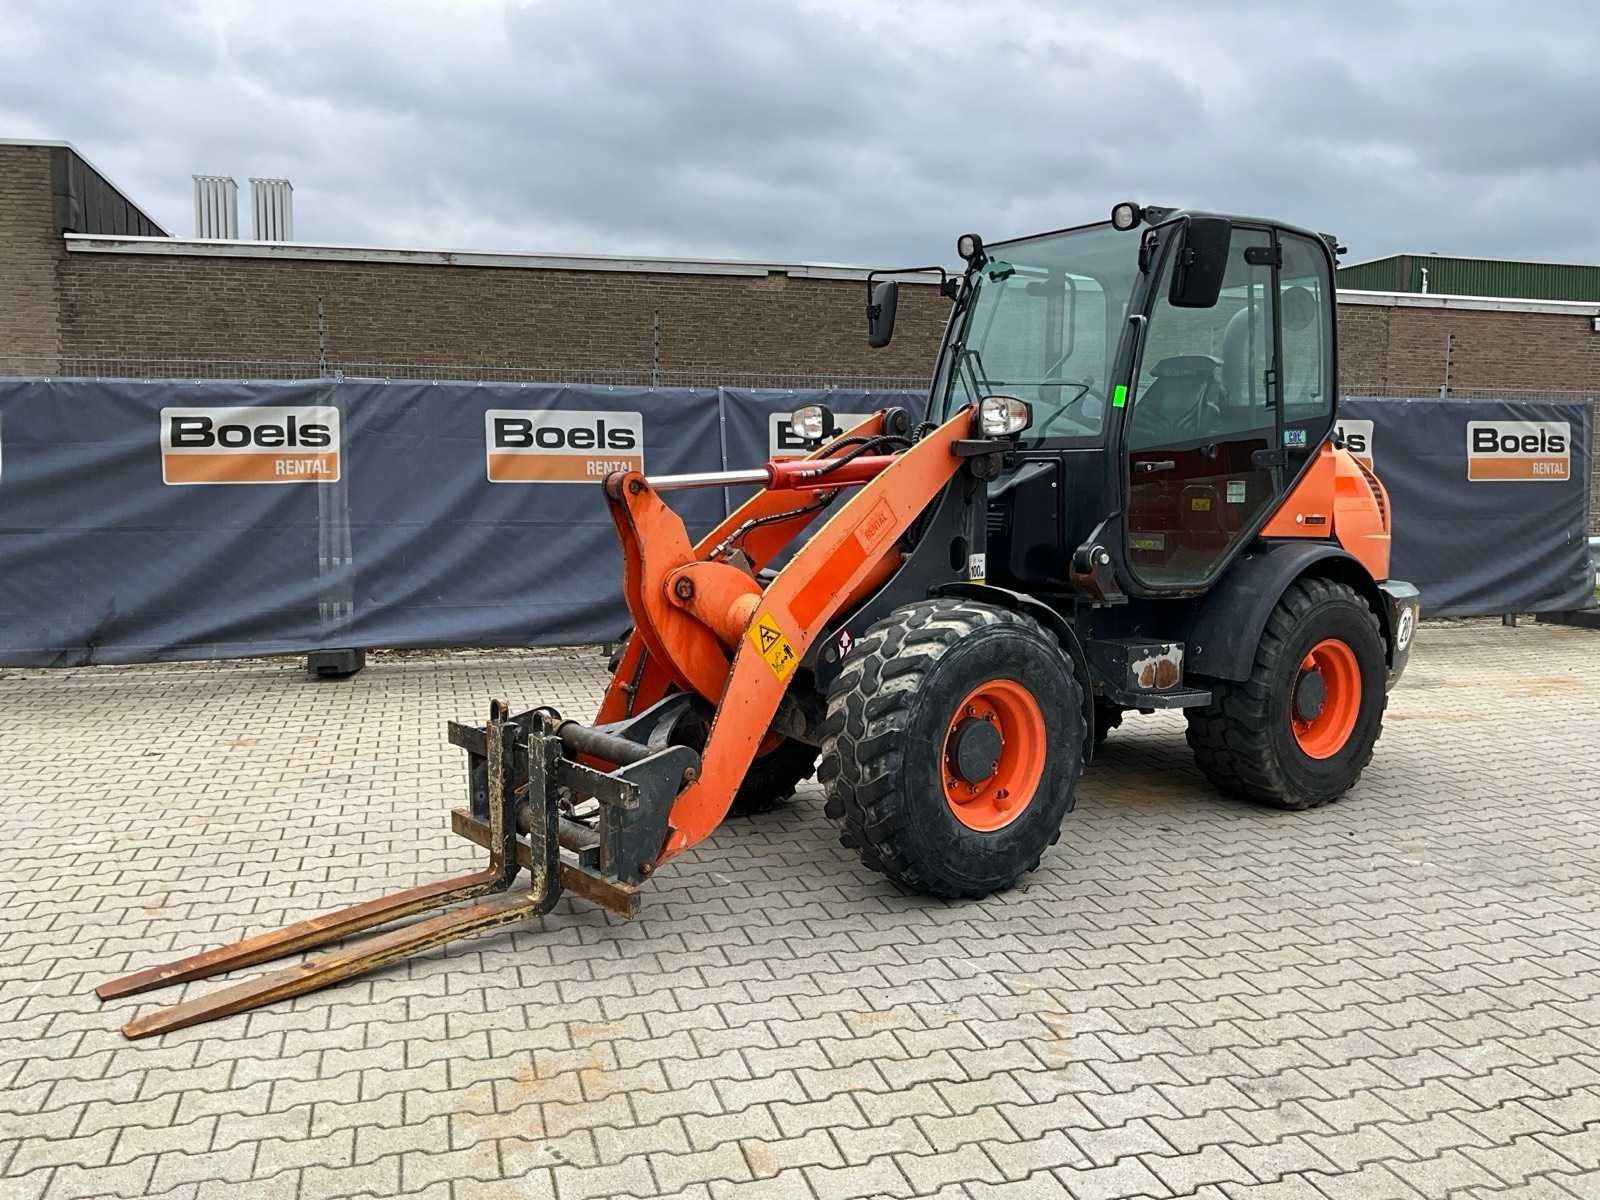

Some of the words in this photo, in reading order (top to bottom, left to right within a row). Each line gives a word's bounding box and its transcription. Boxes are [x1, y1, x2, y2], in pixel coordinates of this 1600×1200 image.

[171, 415, 331, 447] Boels
[494, 417, 636, 450] Boels
[1473, 428, 1565, 453] Boels
[275, 459, 331, 475] RENTAL
[1532, 463, 1565, 475] RENTAL
